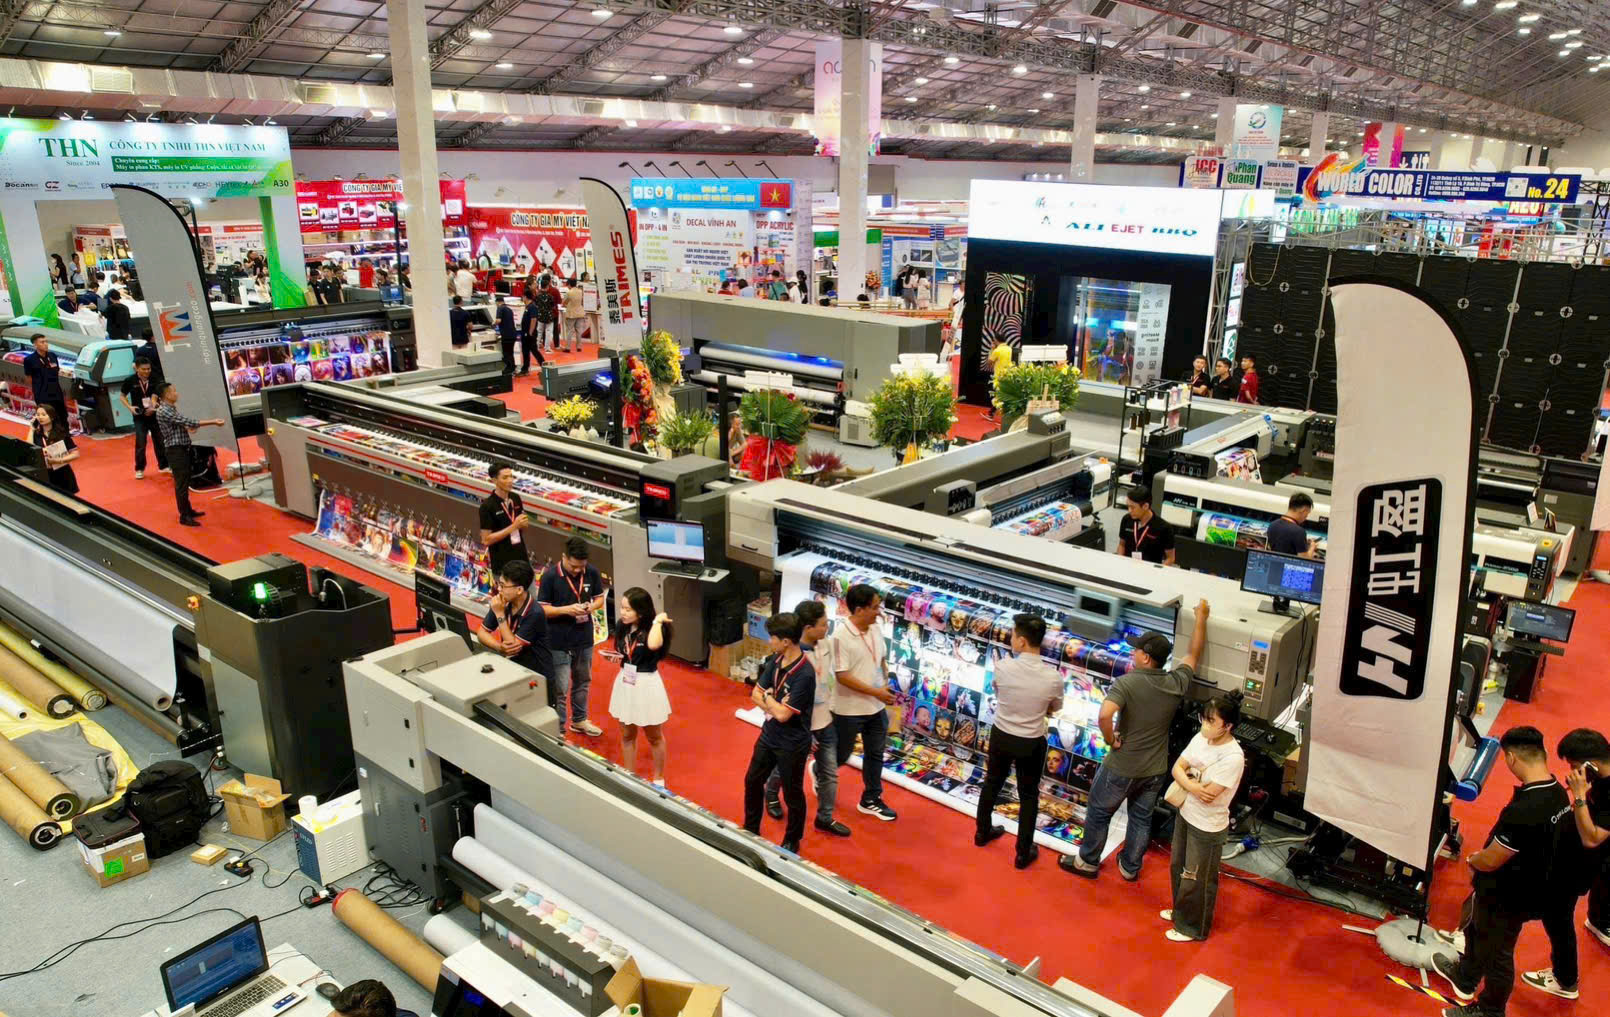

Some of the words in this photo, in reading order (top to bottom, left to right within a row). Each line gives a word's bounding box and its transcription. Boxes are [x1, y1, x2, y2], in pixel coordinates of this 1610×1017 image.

[38, 138, 100, 158] THN
[109, 139, 142, 150] CÔNG
[146, 142, 157, 150] TY
[162, 142, 191, 151] TNHH
[243, 143, 265, 151] NAM
[1227, 173, 1256, 185] Quang
[1317, 172, 1366, 192] WORLD
[1368, 173, 1414, 195] COLOR
[1528, 187, 1543, 198] No.
[1544, 178, 1569, 199] 24
[531, 214, 538, 225] TY
[540, 215, 551, 226] GIA
[686, 218, 706, 227] DECAL
[1111, 224, 1144, 234] EJET
[610, 231, 633, 324] TAIMES
[605, 278, 621, 325] 泰美斯
[1367, 484, 1427, 595] 虹盈
